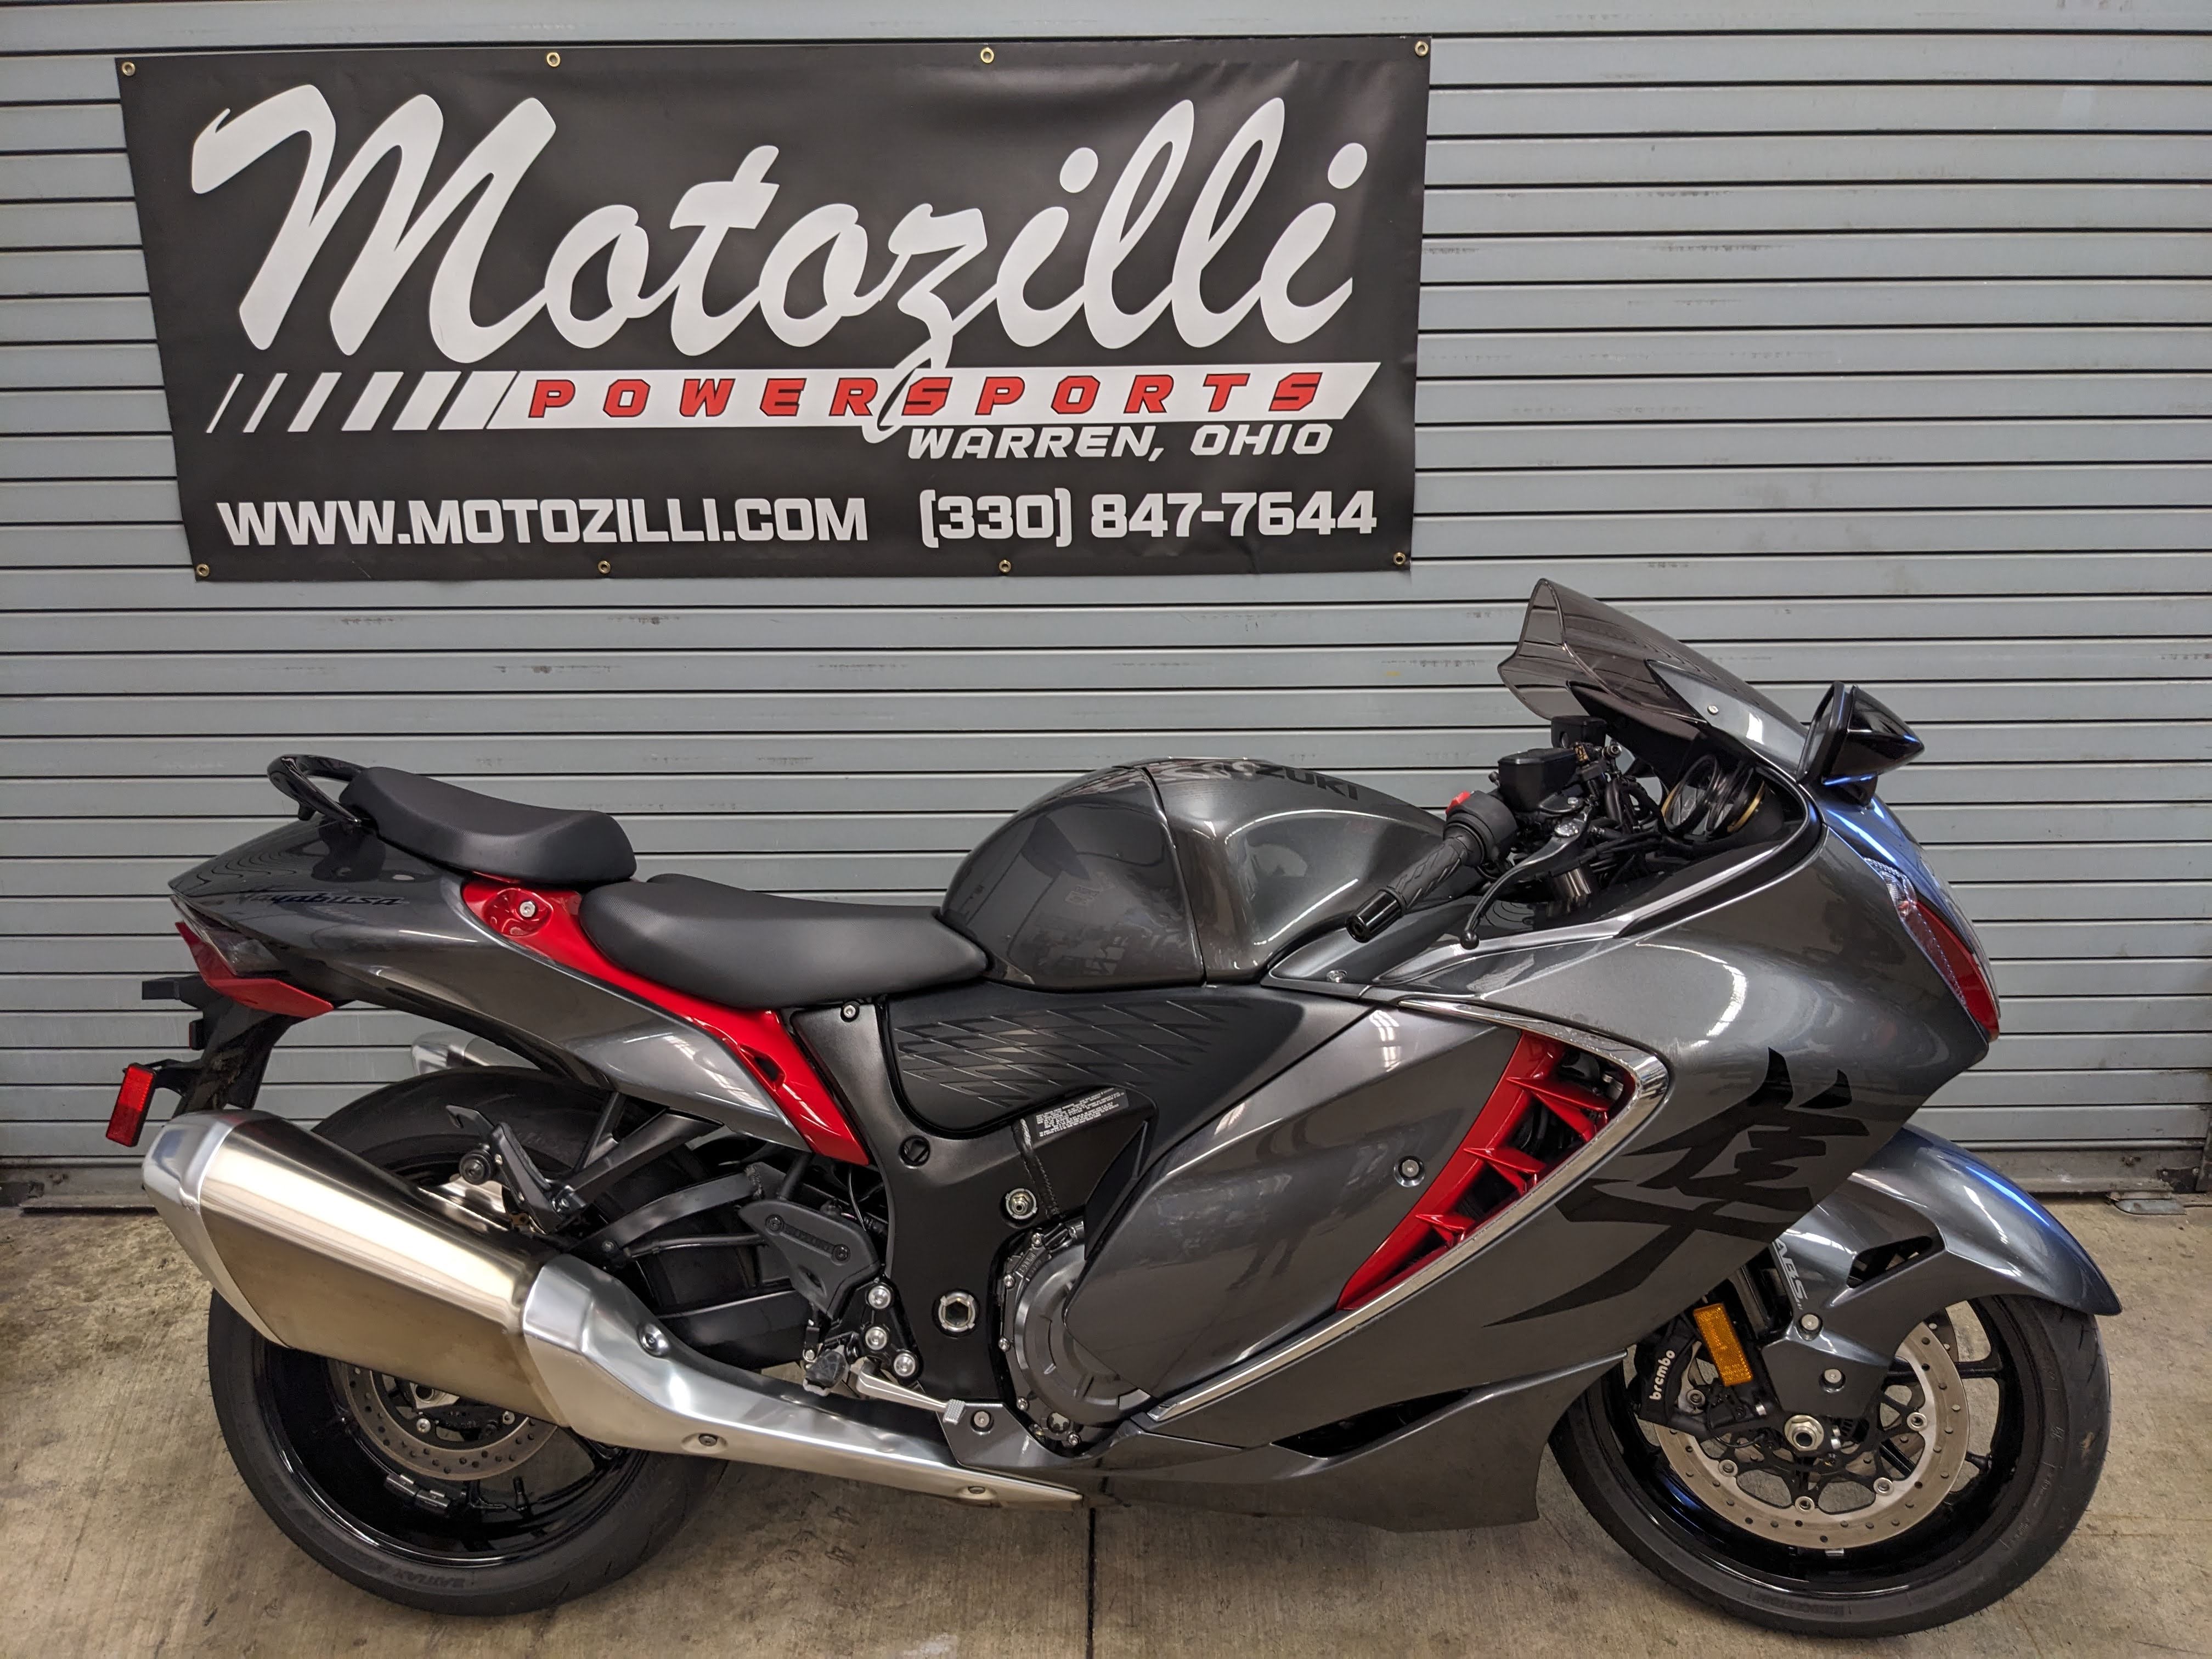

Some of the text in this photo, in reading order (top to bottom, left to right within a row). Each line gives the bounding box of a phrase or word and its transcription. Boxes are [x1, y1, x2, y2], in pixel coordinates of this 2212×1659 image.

[191, 84, 1367, 443] Motozilli
[528, 371, 1323, 418] POWERSPORTS
[908, 423, 1333, 461] WARREN, OHIO
[217, 497, 868, 545] WWW.MOTOZILLI.COM
[919, 488, 1377, 548] (330) 847-7644
[1773, 1238, 1808, 1301] ABS
[1649, 1350, 1675, 1400] brembo
